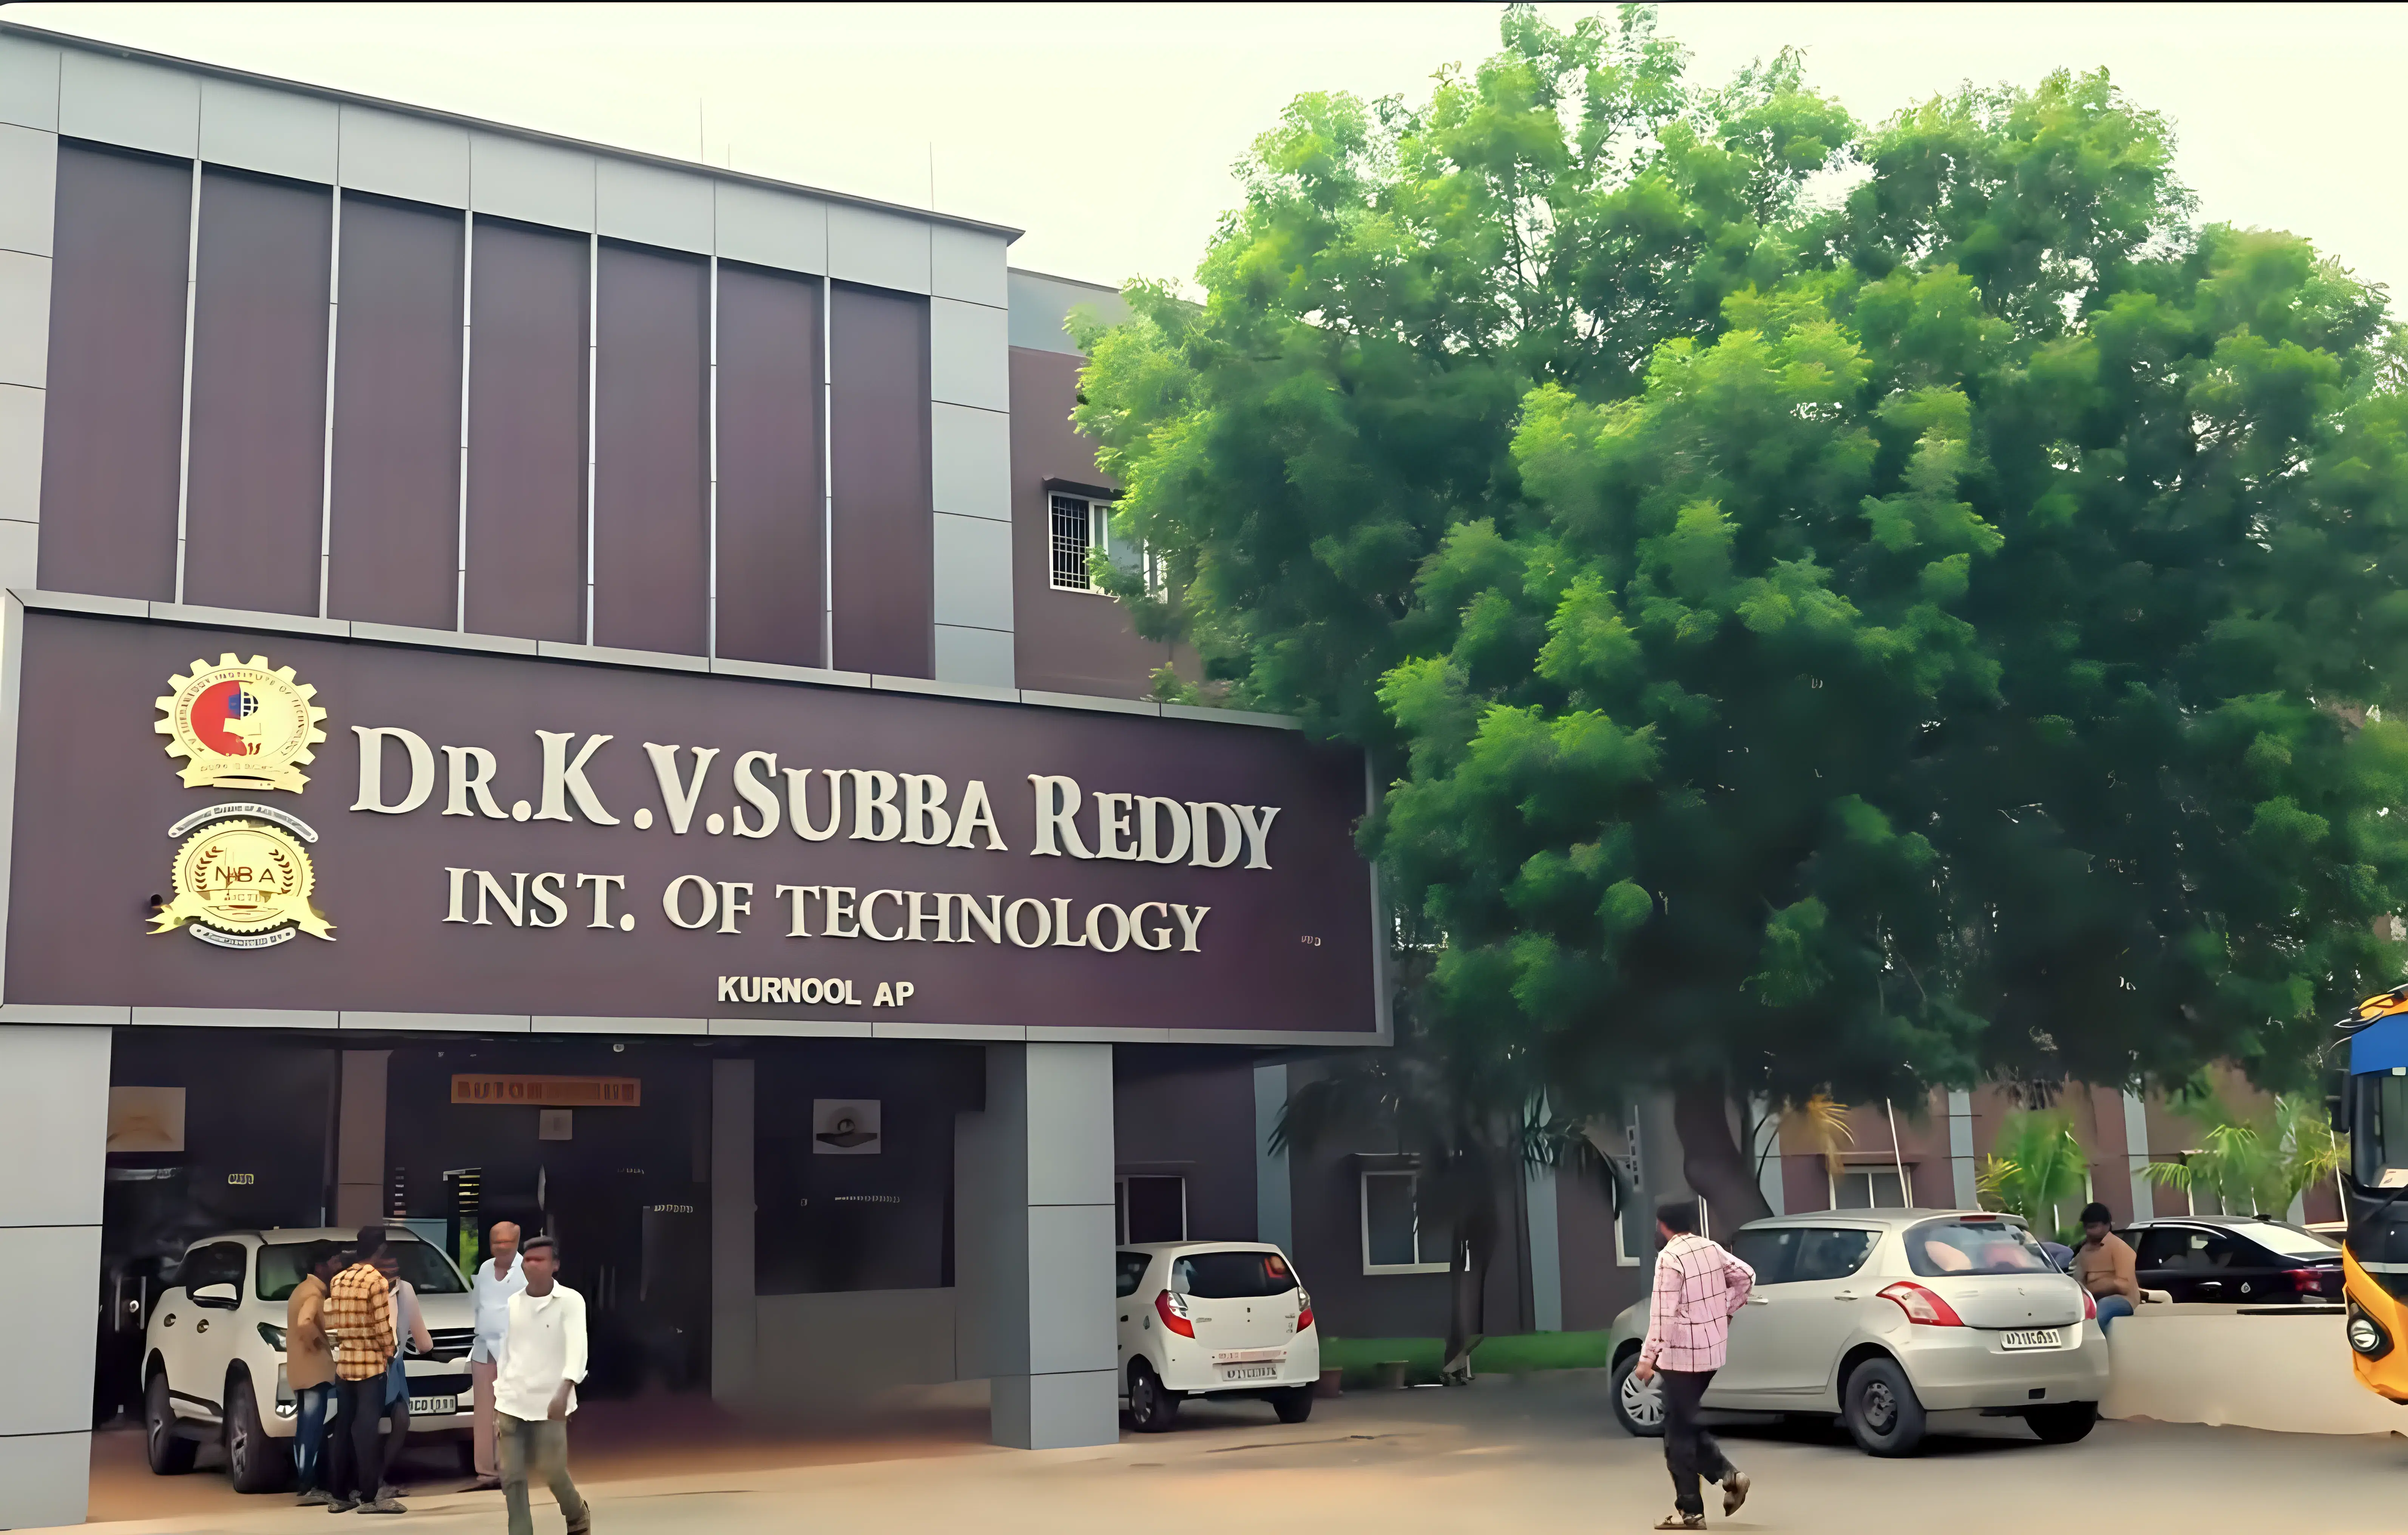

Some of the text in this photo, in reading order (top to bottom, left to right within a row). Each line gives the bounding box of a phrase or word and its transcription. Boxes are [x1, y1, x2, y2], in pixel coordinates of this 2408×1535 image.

[1027, 774, 1282, 870] REDDY
[215, 866, 275, 883] NBA
[441, 866, 1212, 953] INST. OF TECHNOLOGY
[718, 976, 915, 1007] KURNOOL AP
